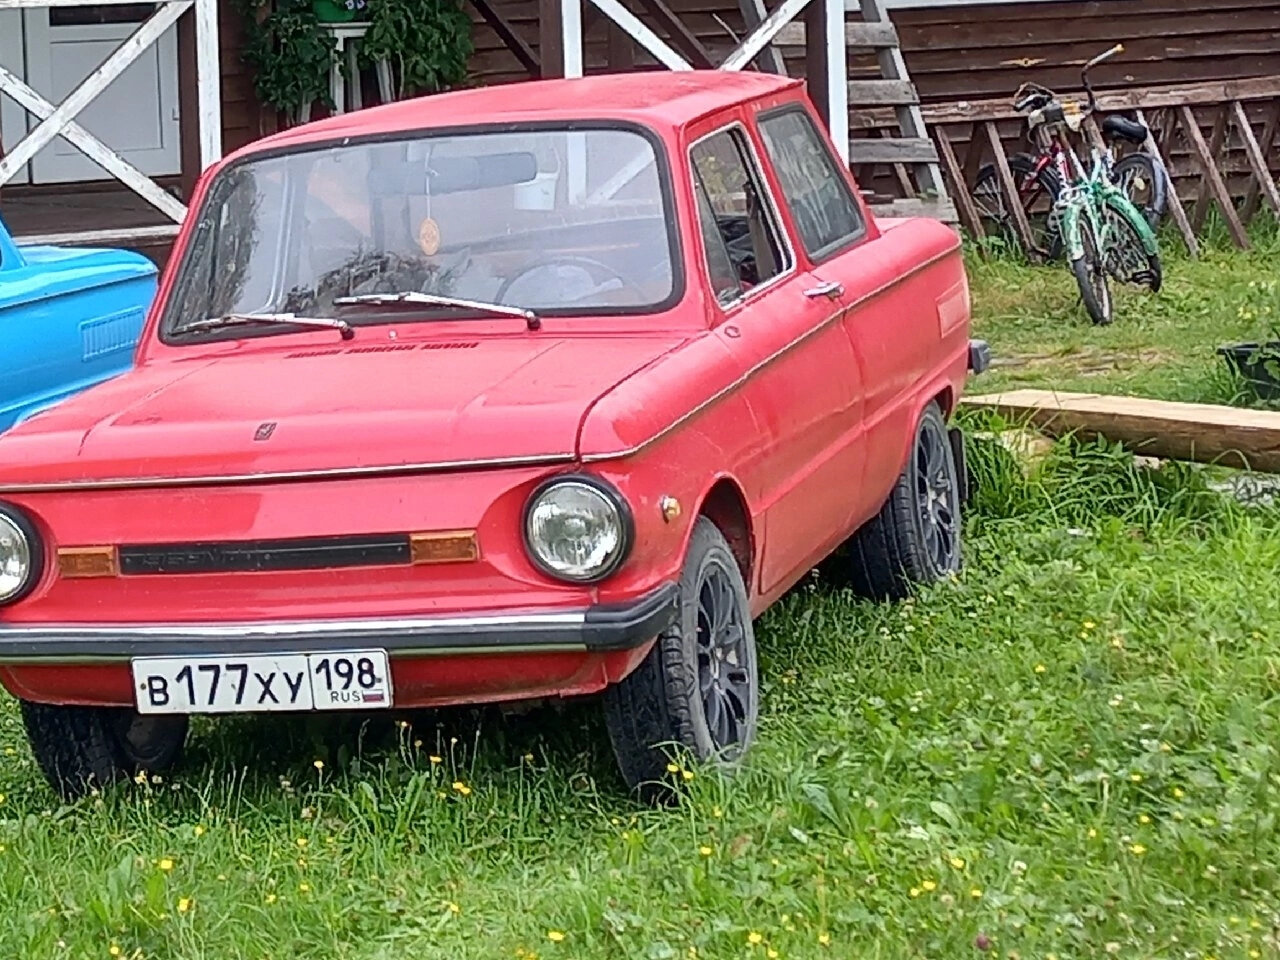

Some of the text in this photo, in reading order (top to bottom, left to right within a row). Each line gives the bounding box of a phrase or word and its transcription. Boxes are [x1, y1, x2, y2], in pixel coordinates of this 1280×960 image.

[147, 657, 377, 707] В177ХУ 198
[330, 690, 361, 703] RUS
